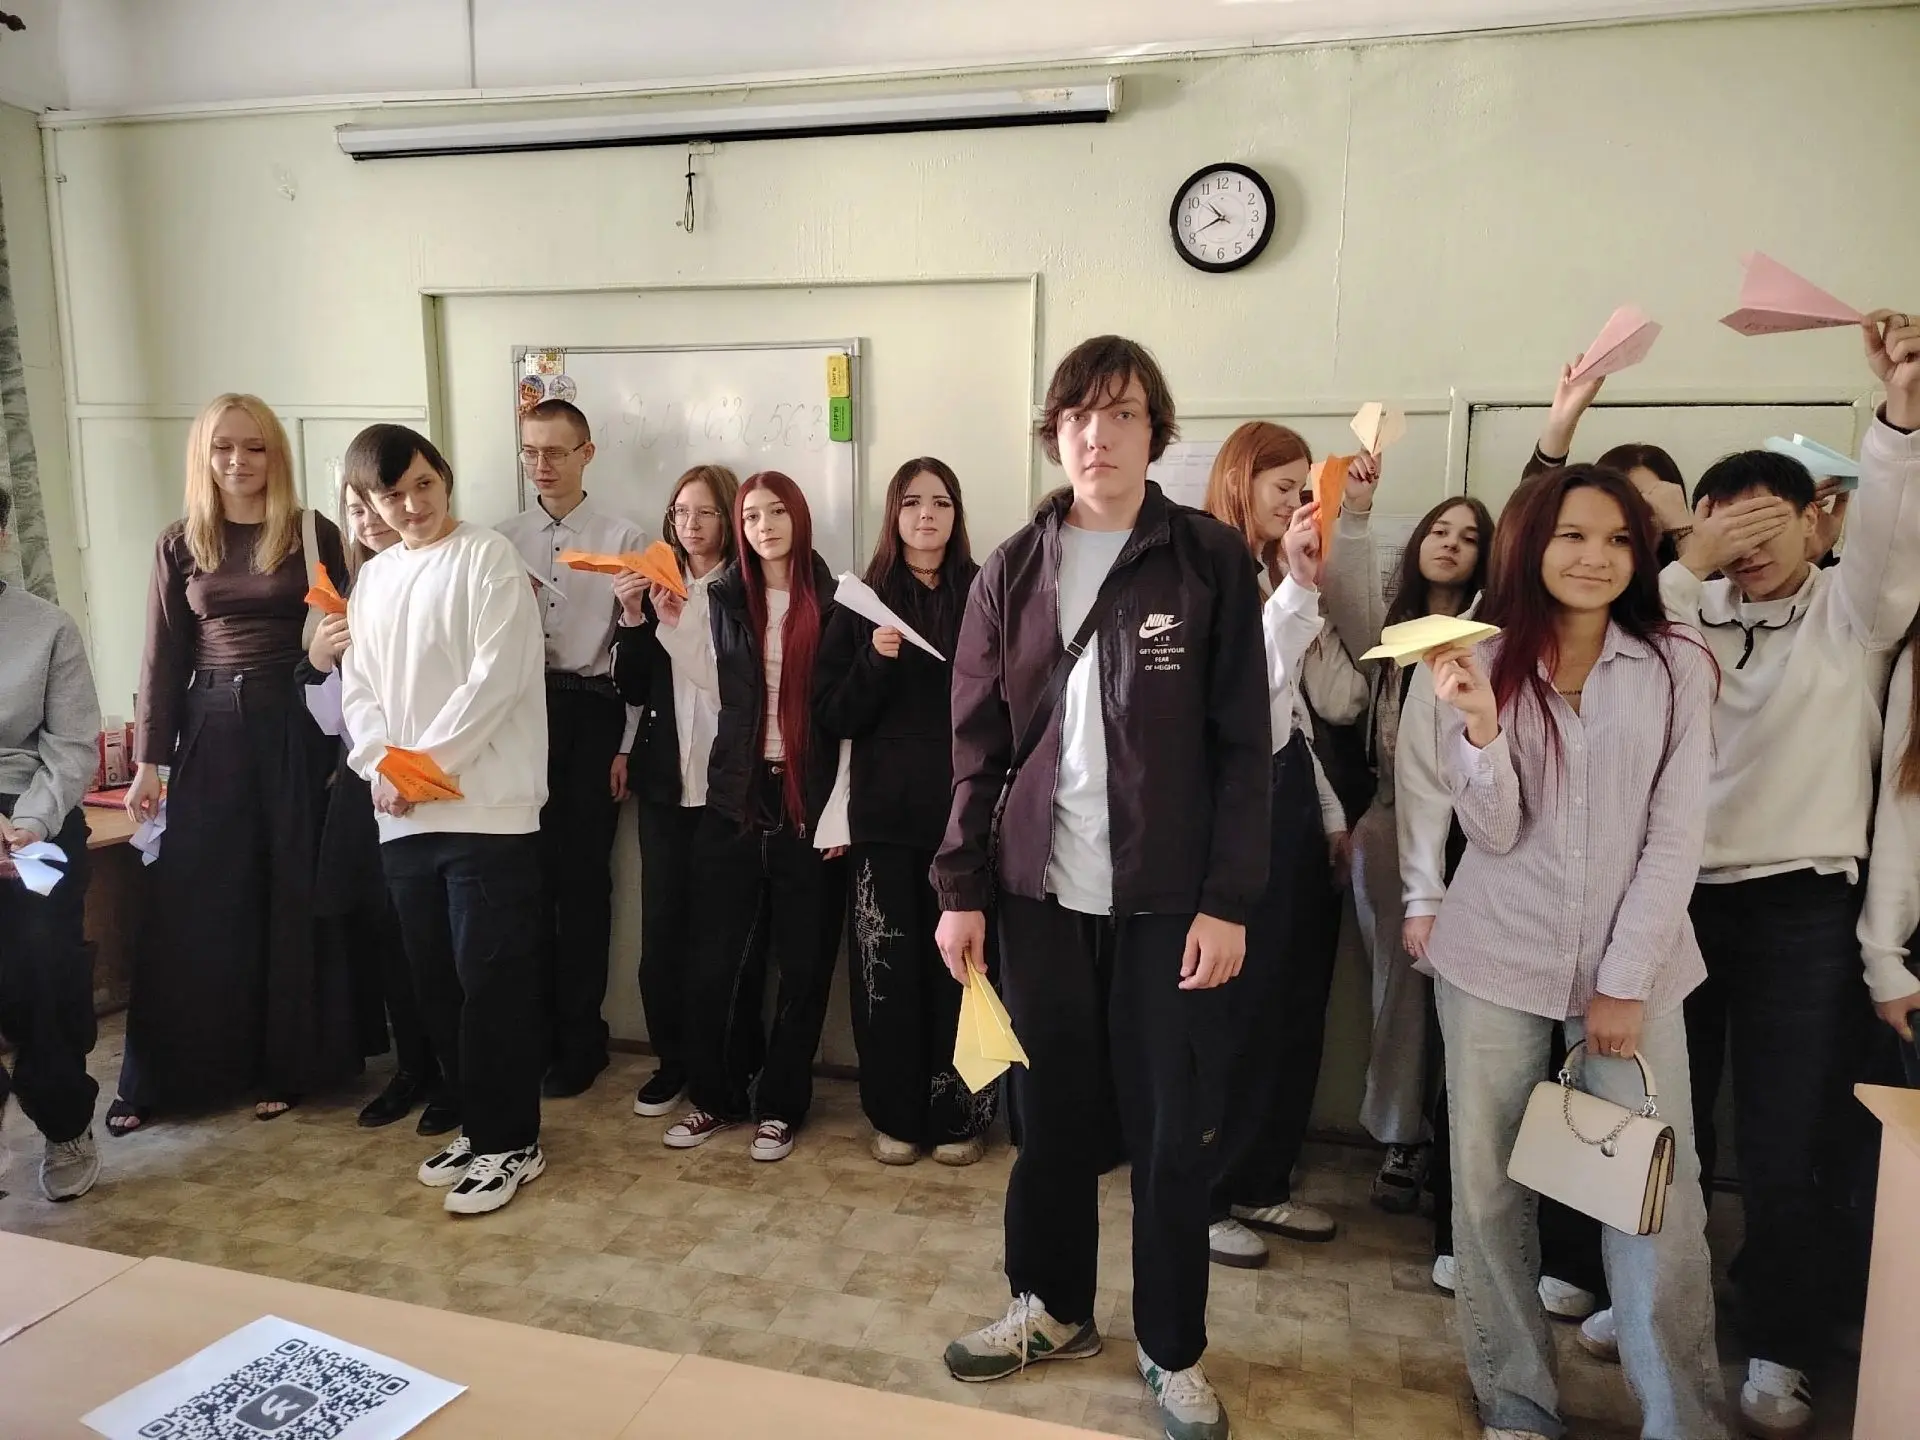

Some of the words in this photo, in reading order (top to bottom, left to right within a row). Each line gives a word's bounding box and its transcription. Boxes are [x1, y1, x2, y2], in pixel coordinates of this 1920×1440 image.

[1201, 183, 1210, 195] 11
[1216, 177, 1229, 190] 12
[1237, 180, 1242, 193] 1
[1187, 197, 1200, 210] 10
[1247, 192, 1256, 206] 2
[1184, 215, 1192, 227] 9
[1251, 210, 1259, 223] 3
[1188, 232, 1196, 245] 8
[1246, 227, 1255, 239] 4
[1200, 244, 1208, 257] 7
[1216, 247, 1225, 260] 6
[1234, 242, 1242, 255] 5
[1145, 613, 1175, 628] NIKE
